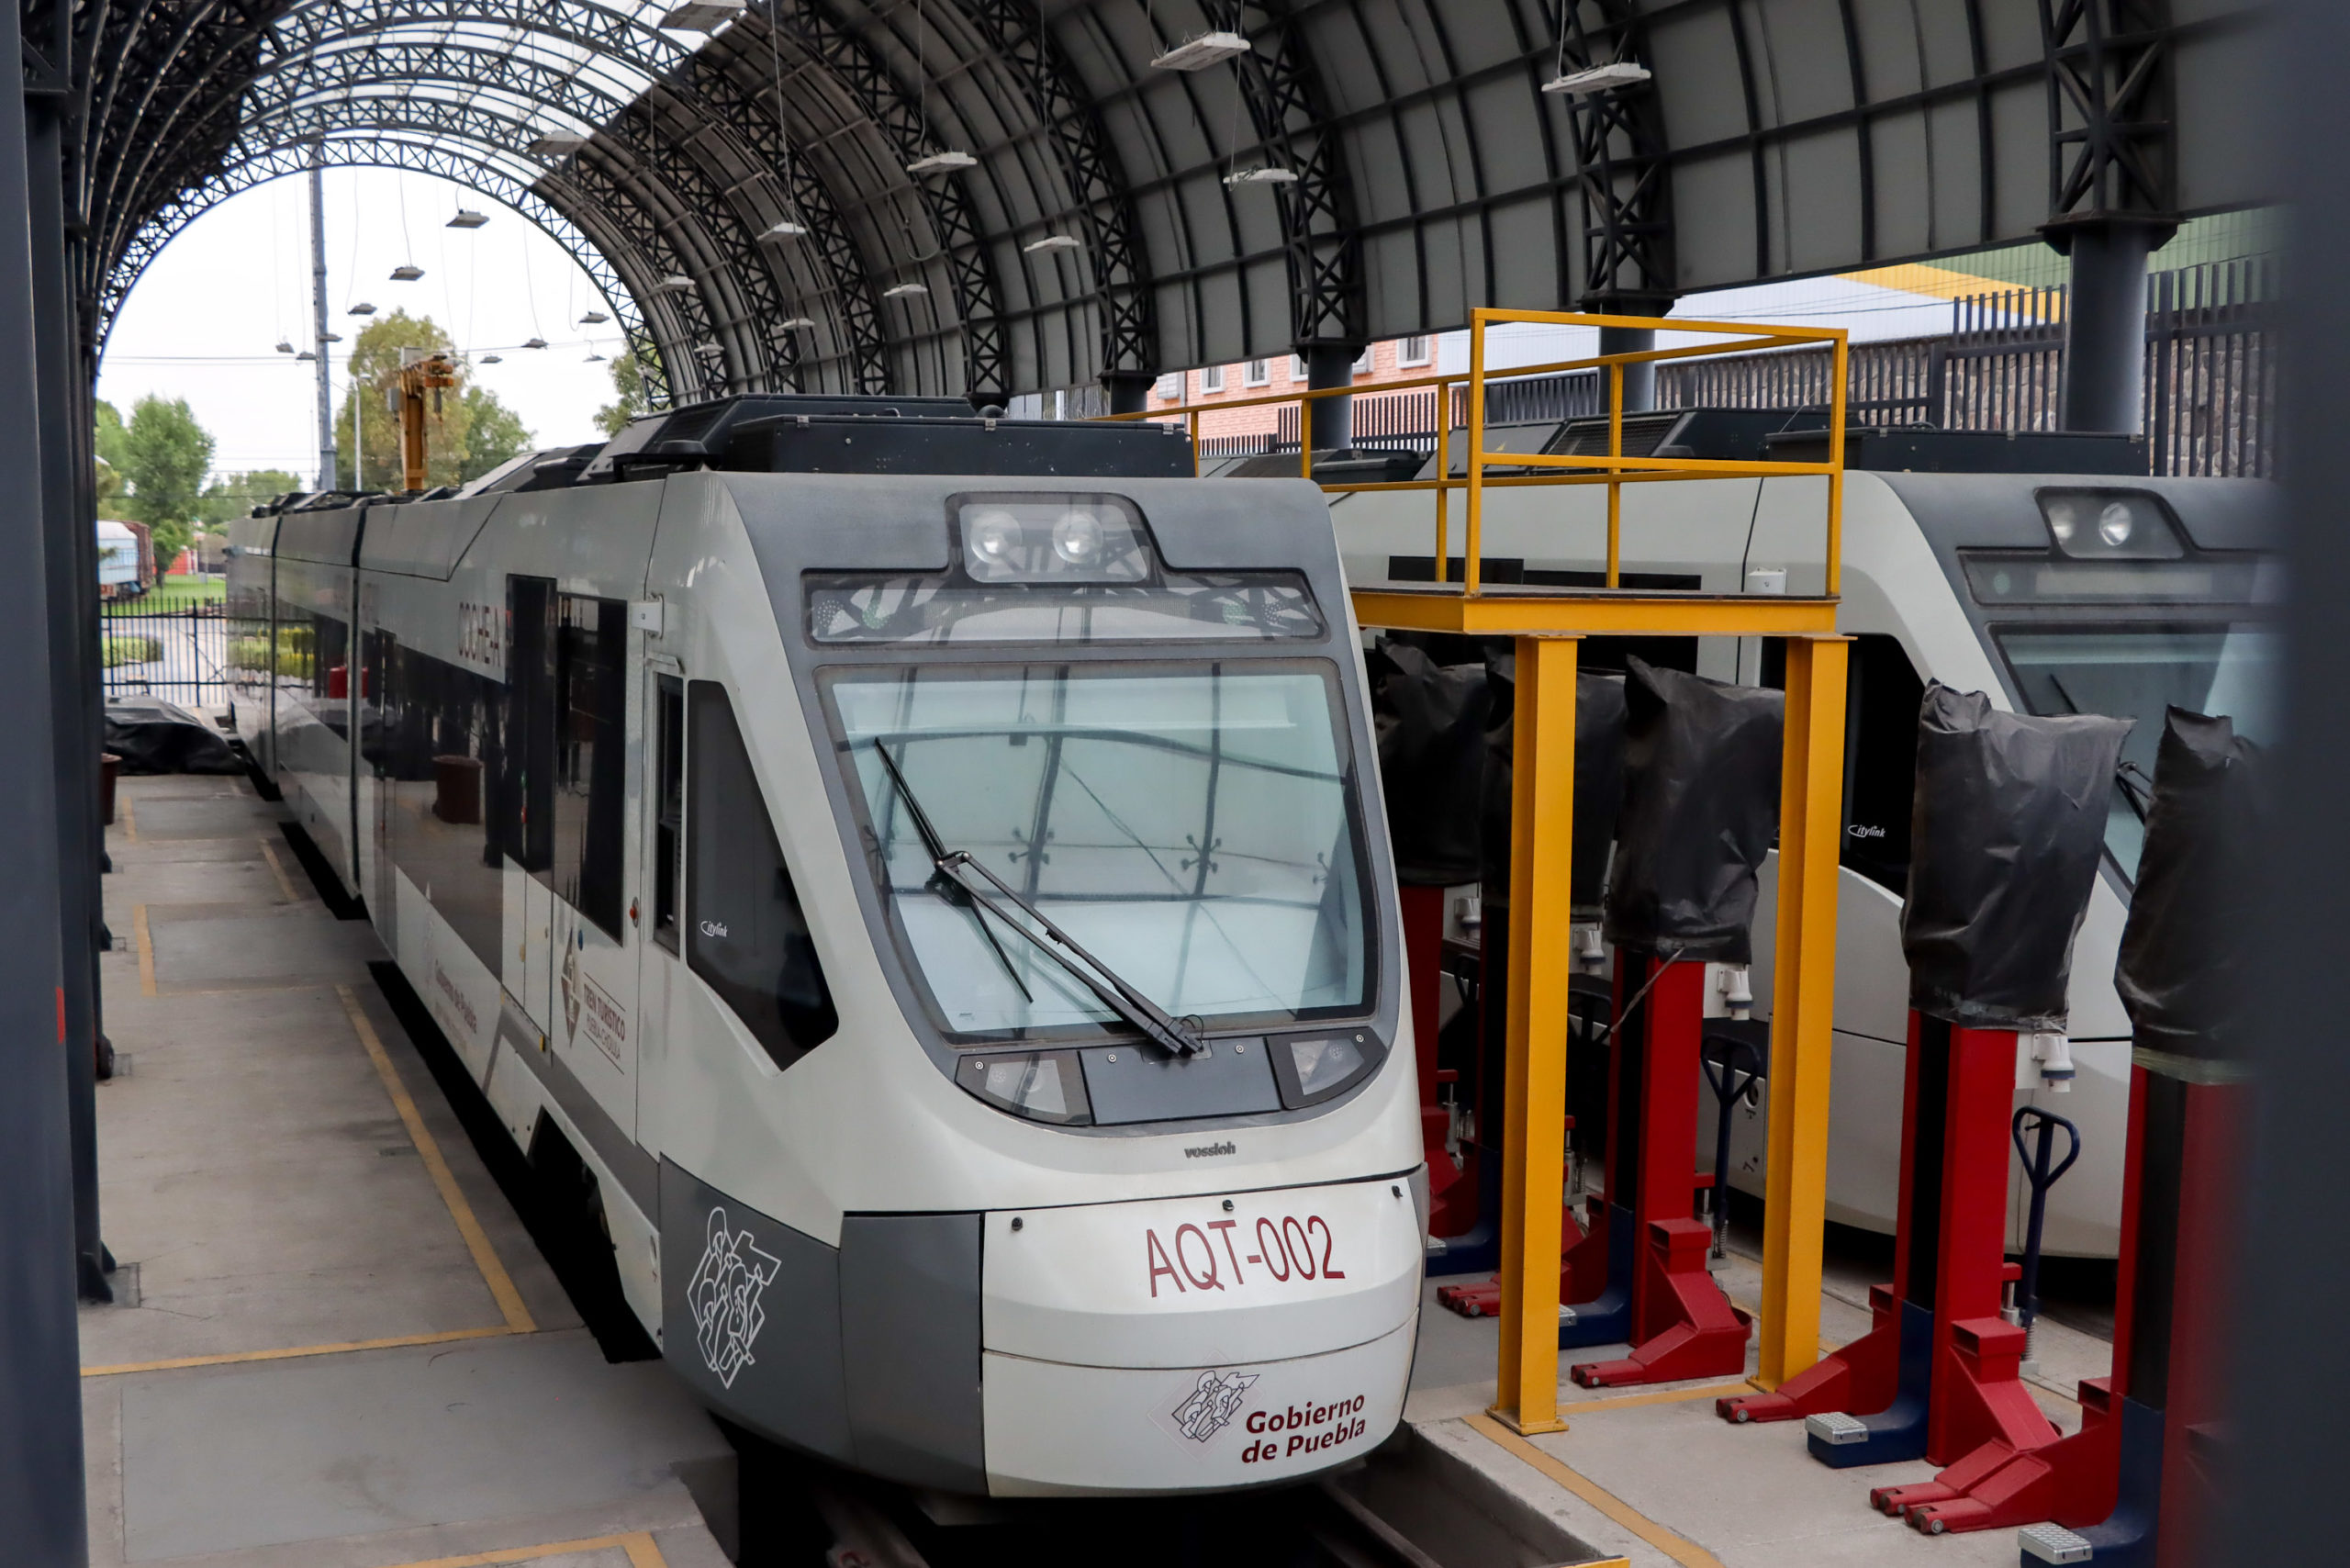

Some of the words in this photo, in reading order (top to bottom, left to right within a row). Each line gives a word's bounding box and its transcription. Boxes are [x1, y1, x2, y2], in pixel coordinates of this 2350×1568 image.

[1847, 823, 1886, 838] Citylink
[699, 920, 728, 938] Citylink
[583, 983, 598, 1014] TREN
[1183, 1140, 1237, 1159] vossloh
[1146, 1215, 1346, 1298] AQT-002
[1246, 1394, 1366, 1434] Gobierno
[1241, 1439, 1278, 1464] de
[1286, 1417, 1367, 1458] Puebla
